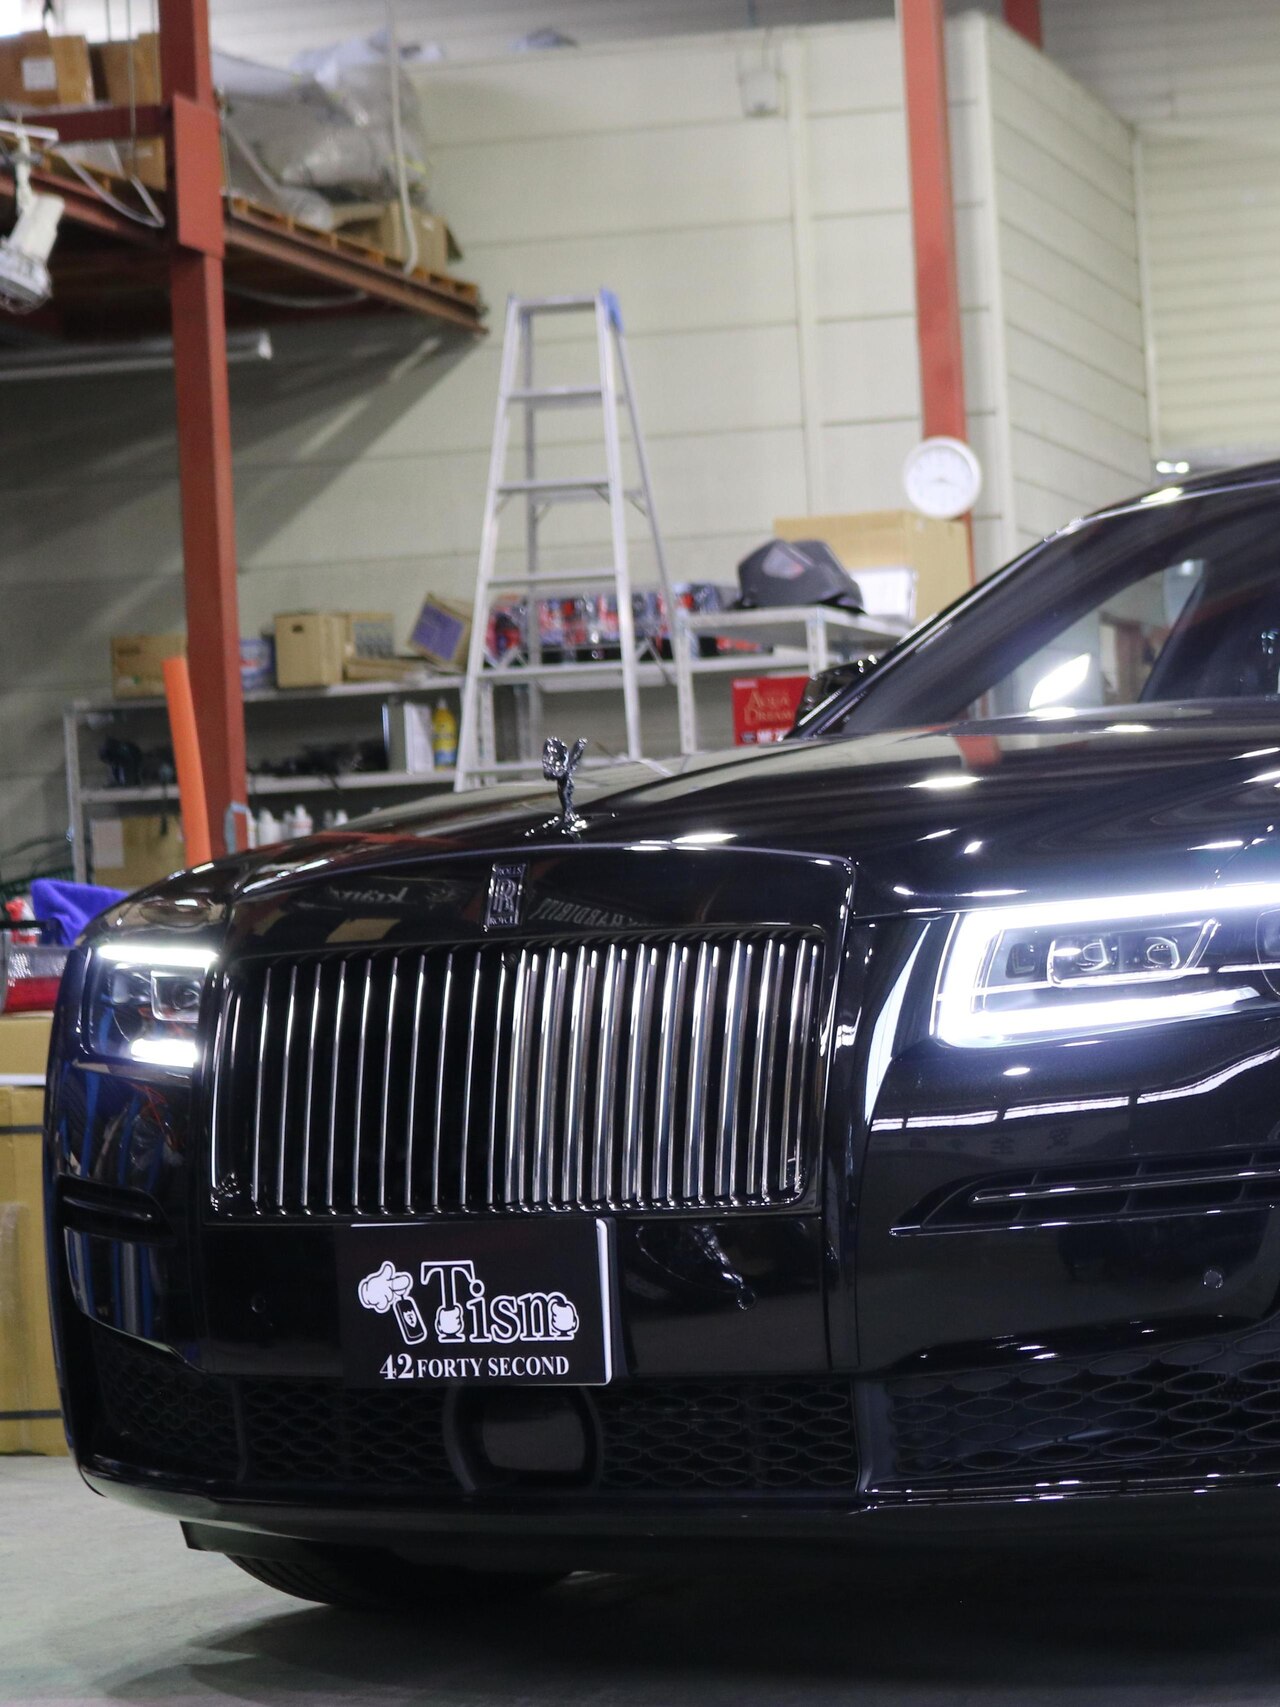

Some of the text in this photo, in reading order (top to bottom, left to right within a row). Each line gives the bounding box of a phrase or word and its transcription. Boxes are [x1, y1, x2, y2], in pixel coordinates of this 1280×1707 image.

[420, 1260, 579, 1344] Tism
[379, 1353, 570, 1380] 42 FORTY SECOND
